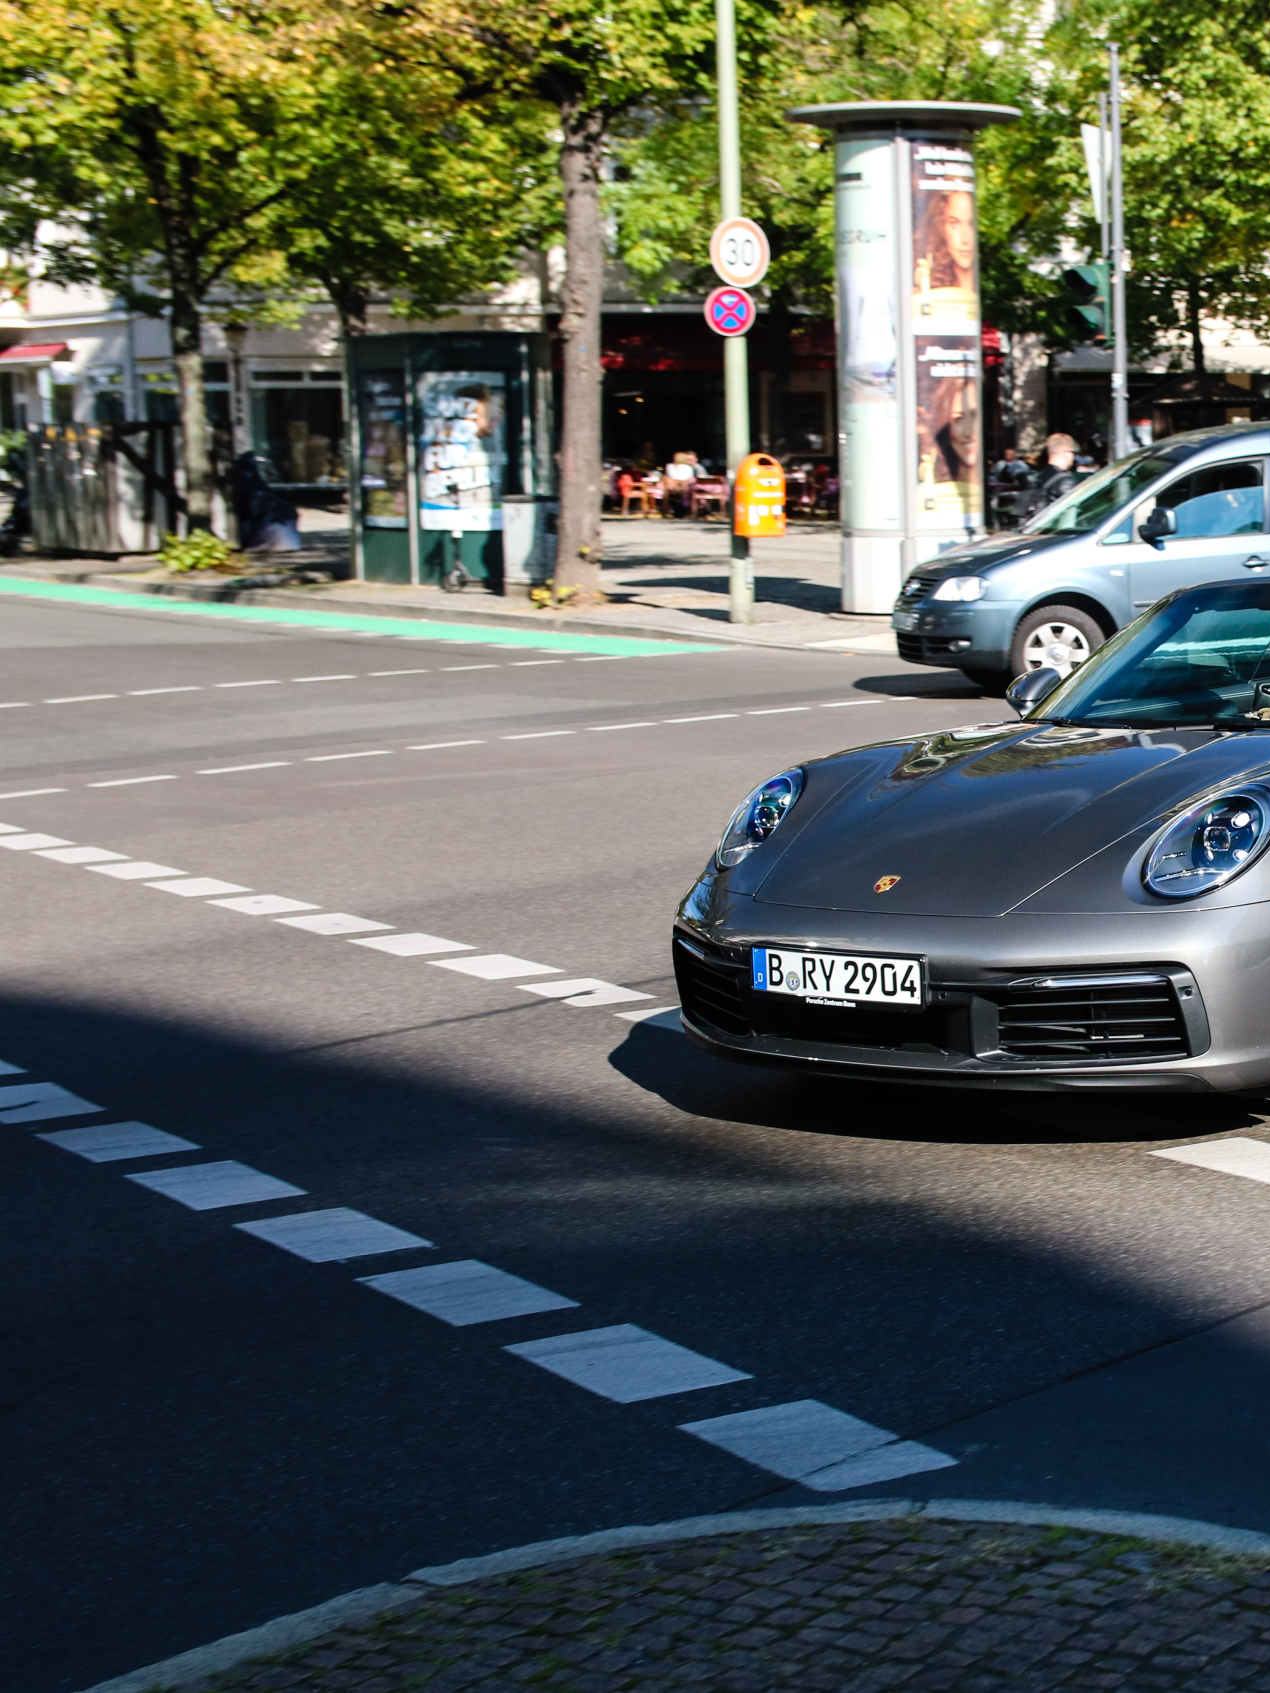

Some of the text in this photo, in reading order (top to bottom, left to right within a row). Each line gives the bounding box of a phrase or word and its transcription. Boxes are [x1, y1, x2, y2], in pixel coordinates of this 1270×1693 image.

[726, 238, 754, 266] 30
[757, 953, 917, 998] D B RY 2904
[805, 996, 824, 1005] Porsche
[823, 998, 844, 1007] Zentrum
